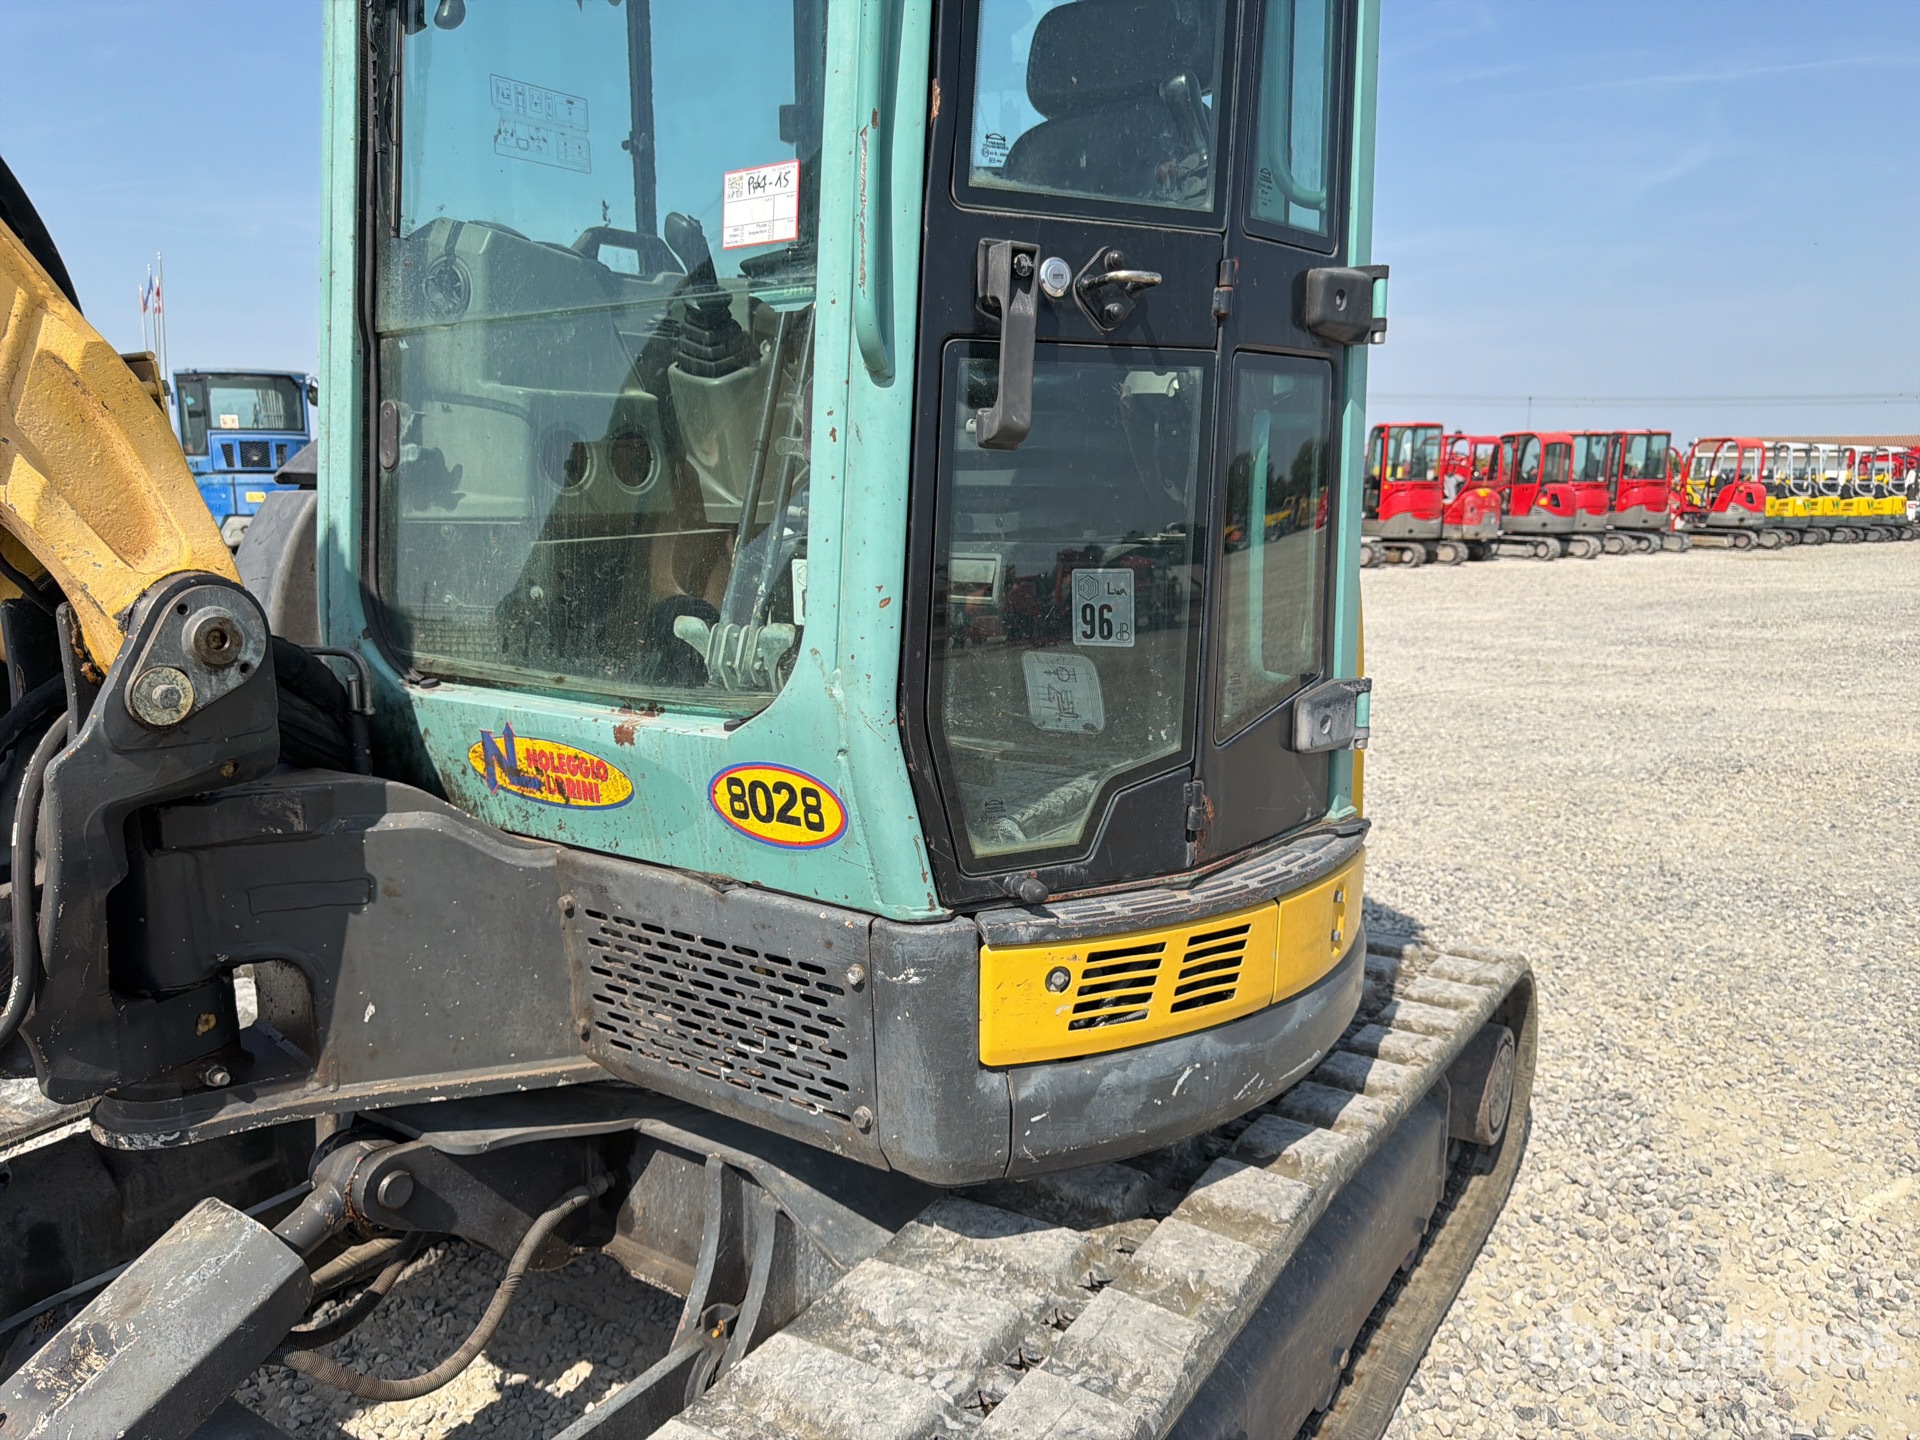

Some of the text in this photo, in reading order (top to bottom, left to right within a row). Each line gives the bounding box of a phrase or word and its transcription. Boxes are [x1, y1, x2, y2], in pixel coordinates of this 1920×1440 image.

[1081, 603, 1130, 641] 96 dB
[525, 747, 609, 782] NOLEGGIO
[726, 776, 825, 833] 8028
